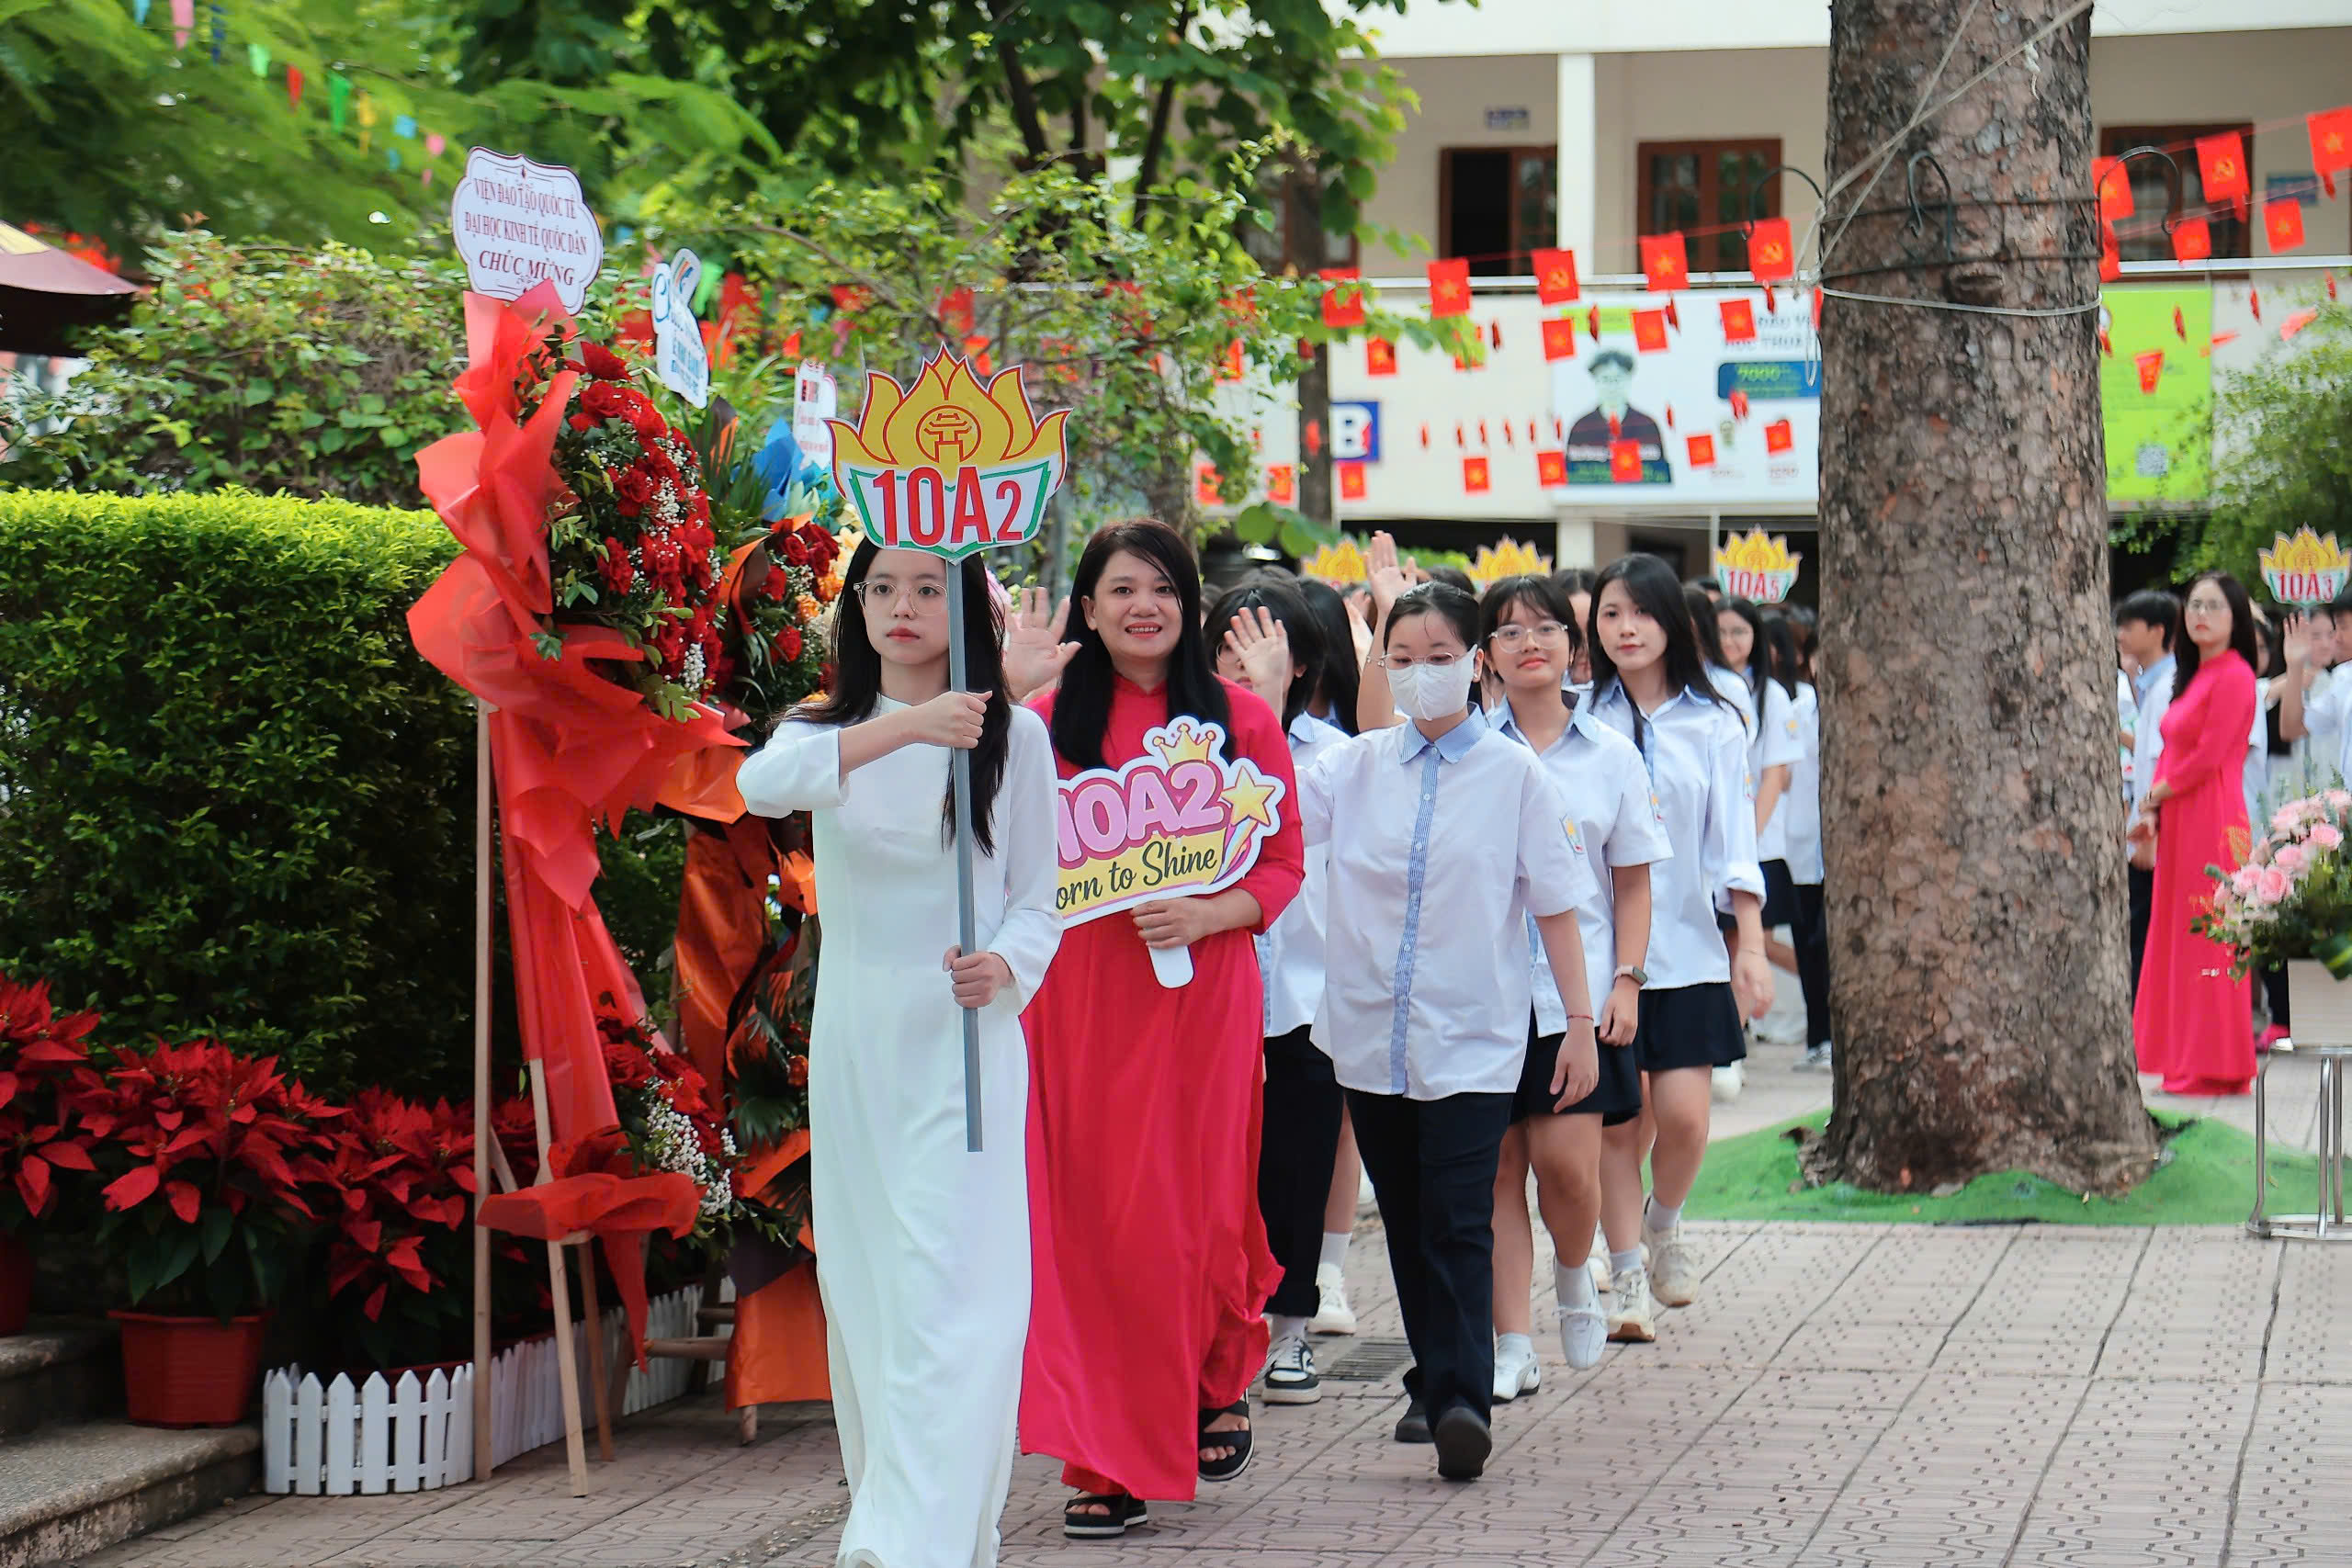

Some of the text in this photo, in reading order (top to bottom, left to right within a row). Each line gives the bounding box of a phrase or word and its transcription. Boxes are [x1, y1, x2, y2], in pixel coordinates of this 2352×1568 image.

[503, 220, 526, 243] KINH
[479, 249, 575, 286] CHÚC MỪNG
[873, 466, 1023, 547] 10A2
[2278, 571, 2333, 602] 10A3
[1056, 840, 1217, 909] orn to Shine
